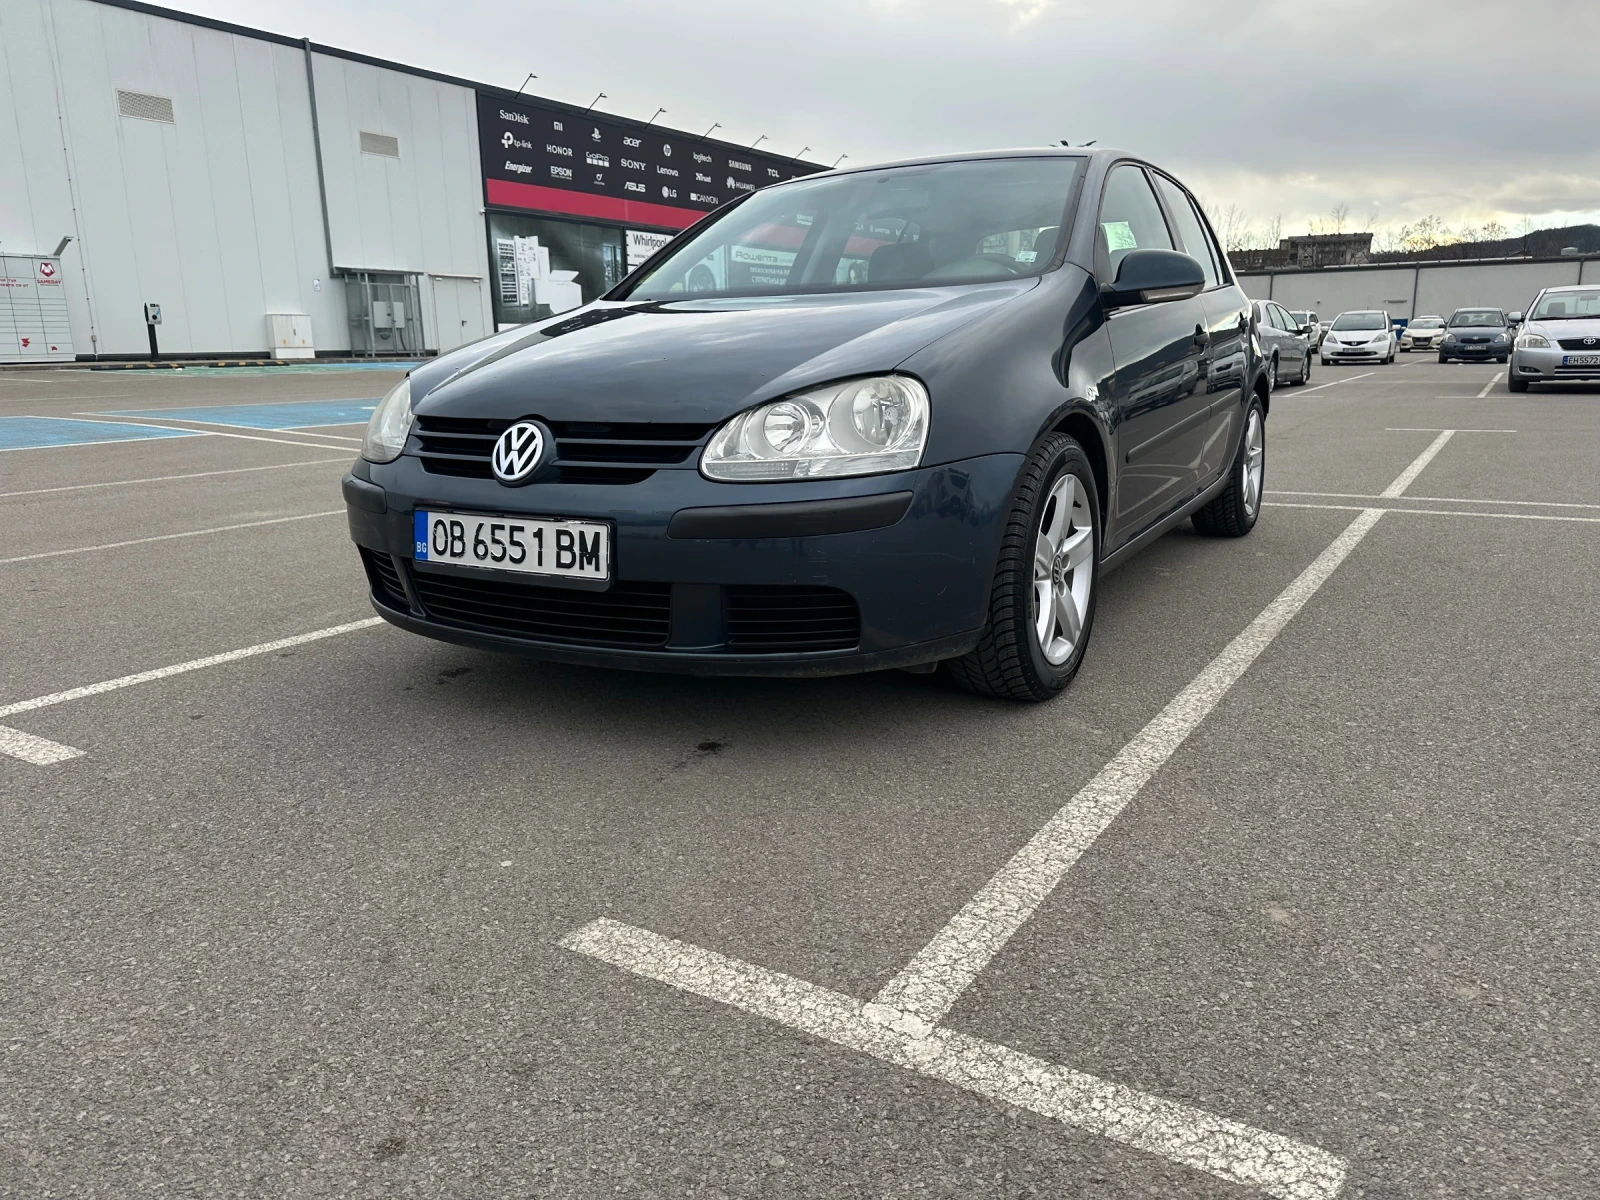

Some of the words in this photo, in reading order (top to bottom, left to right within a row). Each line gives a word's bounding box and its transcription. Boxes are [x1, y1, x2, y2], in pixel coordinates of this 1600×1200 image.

[499, 109, 530, 125] SanDisk
[623, 136, 642, 148] acer
[546, 144, 573, 157] HONOR
[585, 151, 610, 162] GoPro
[692, 151, 712, 164] logitech
[504, 160, 533, 174] Energizer
[620, 158, 647, 171] SONY
[728, 159, 752, 172] SAMSUNG
[550, 166, 573, 178] EPSON
[656, 165, 679, 177] Lenovo
[767, 168, 780, 178] TCL
[624, 181, 646, 193] ASUS
[735, 182, 756, 192] HUAWEI
[696, 193, 719, 205] CANYON
[632, 233, 668, 250] Whirlpool
[416, 541, 427, 553] BG
[432, 518, 466, 558] OB
[472, 522, 545, 567] 6551
[555, 527, 601, 572] BM
